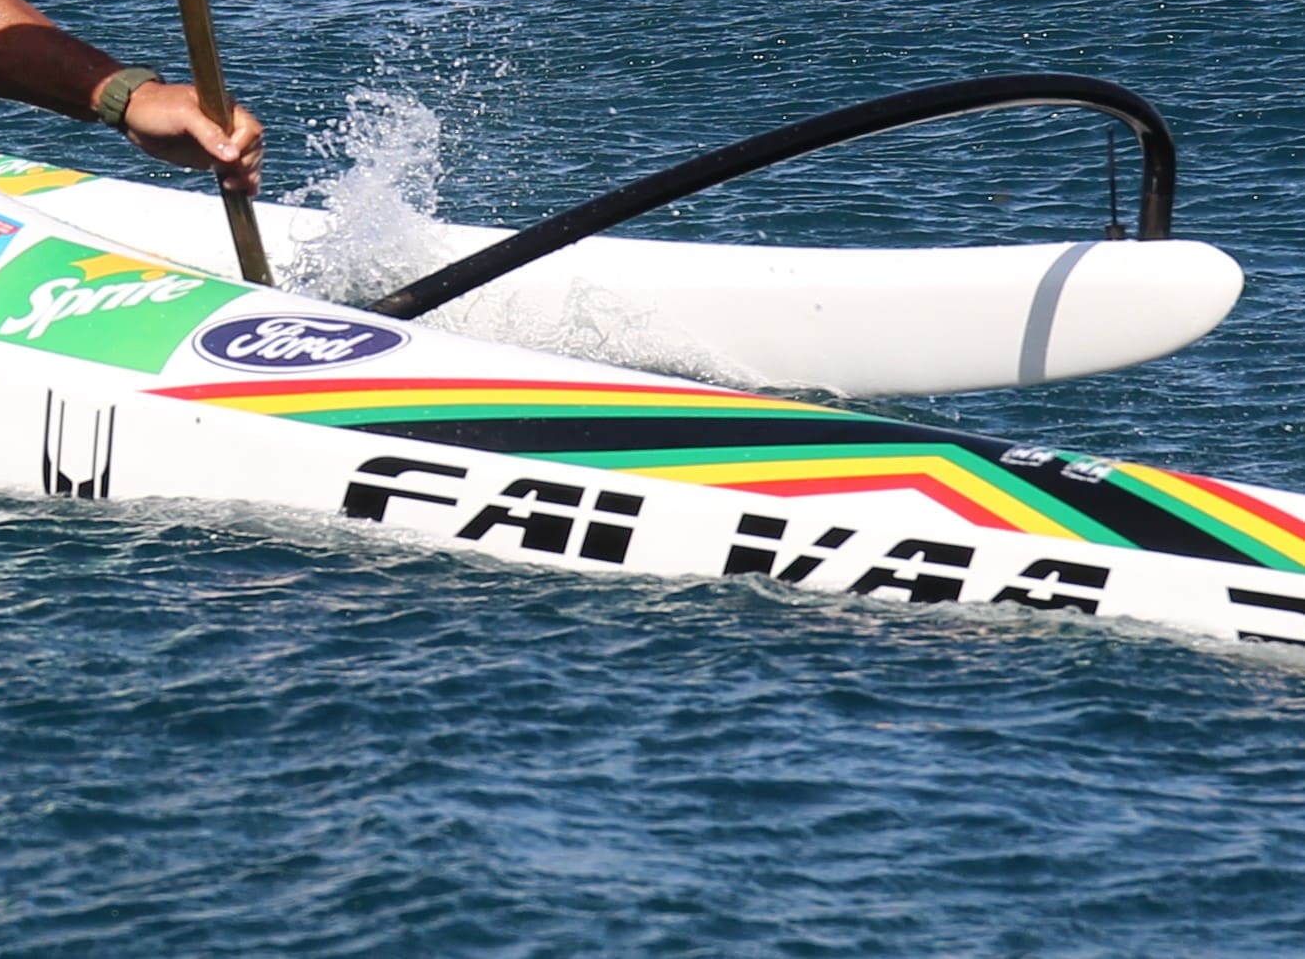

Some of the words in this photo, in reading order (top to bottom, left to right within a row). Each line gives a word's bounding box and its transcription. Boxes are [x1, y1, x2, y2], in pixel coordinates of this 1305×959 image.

[0, 276, 204, 340] Sprite
[226, 317, 374, 362] Ford
[340, 456, 645, 564] FAI
